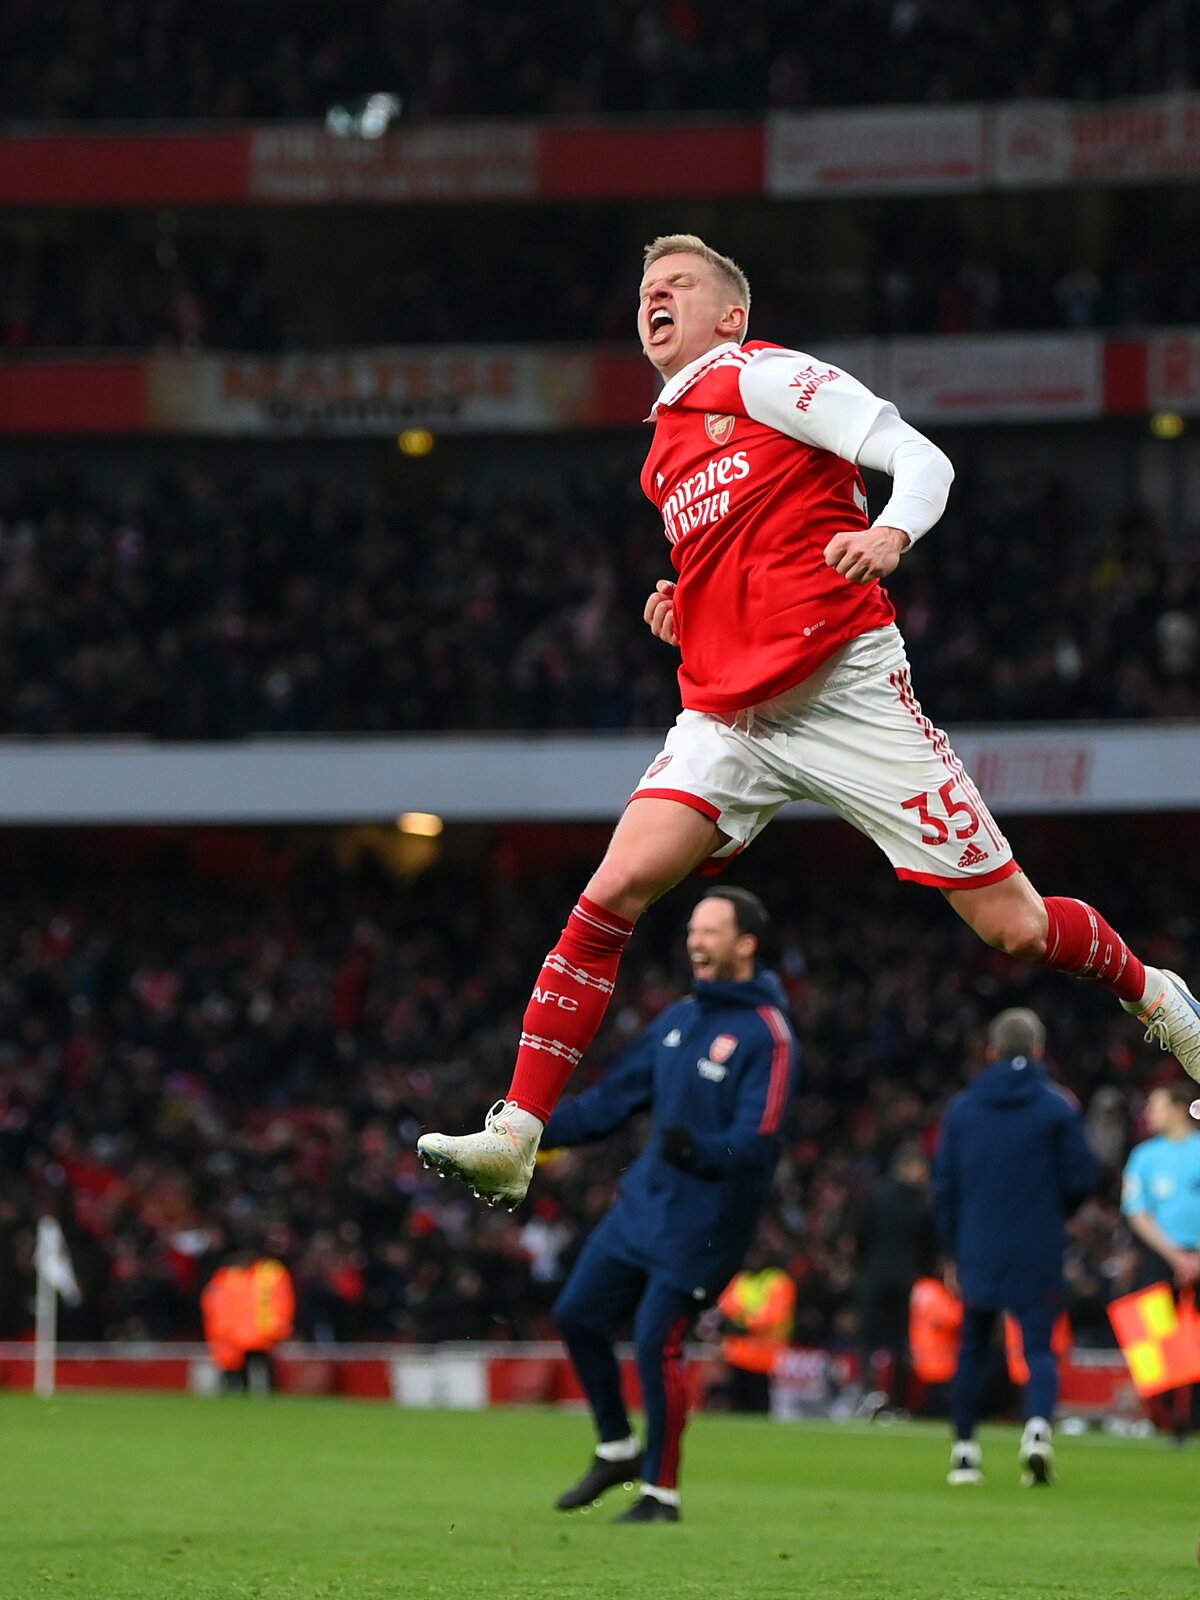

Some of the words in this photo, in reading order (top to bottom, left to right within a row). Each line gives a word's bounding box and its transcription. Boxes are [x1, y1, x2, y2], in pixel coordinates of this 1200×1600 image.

[662, 450, 751, 522] mirates
[900, 778, 980, 846] 35
[957, 852, 990, 868] adidas
[531, 986, 580, 1012] AFC
